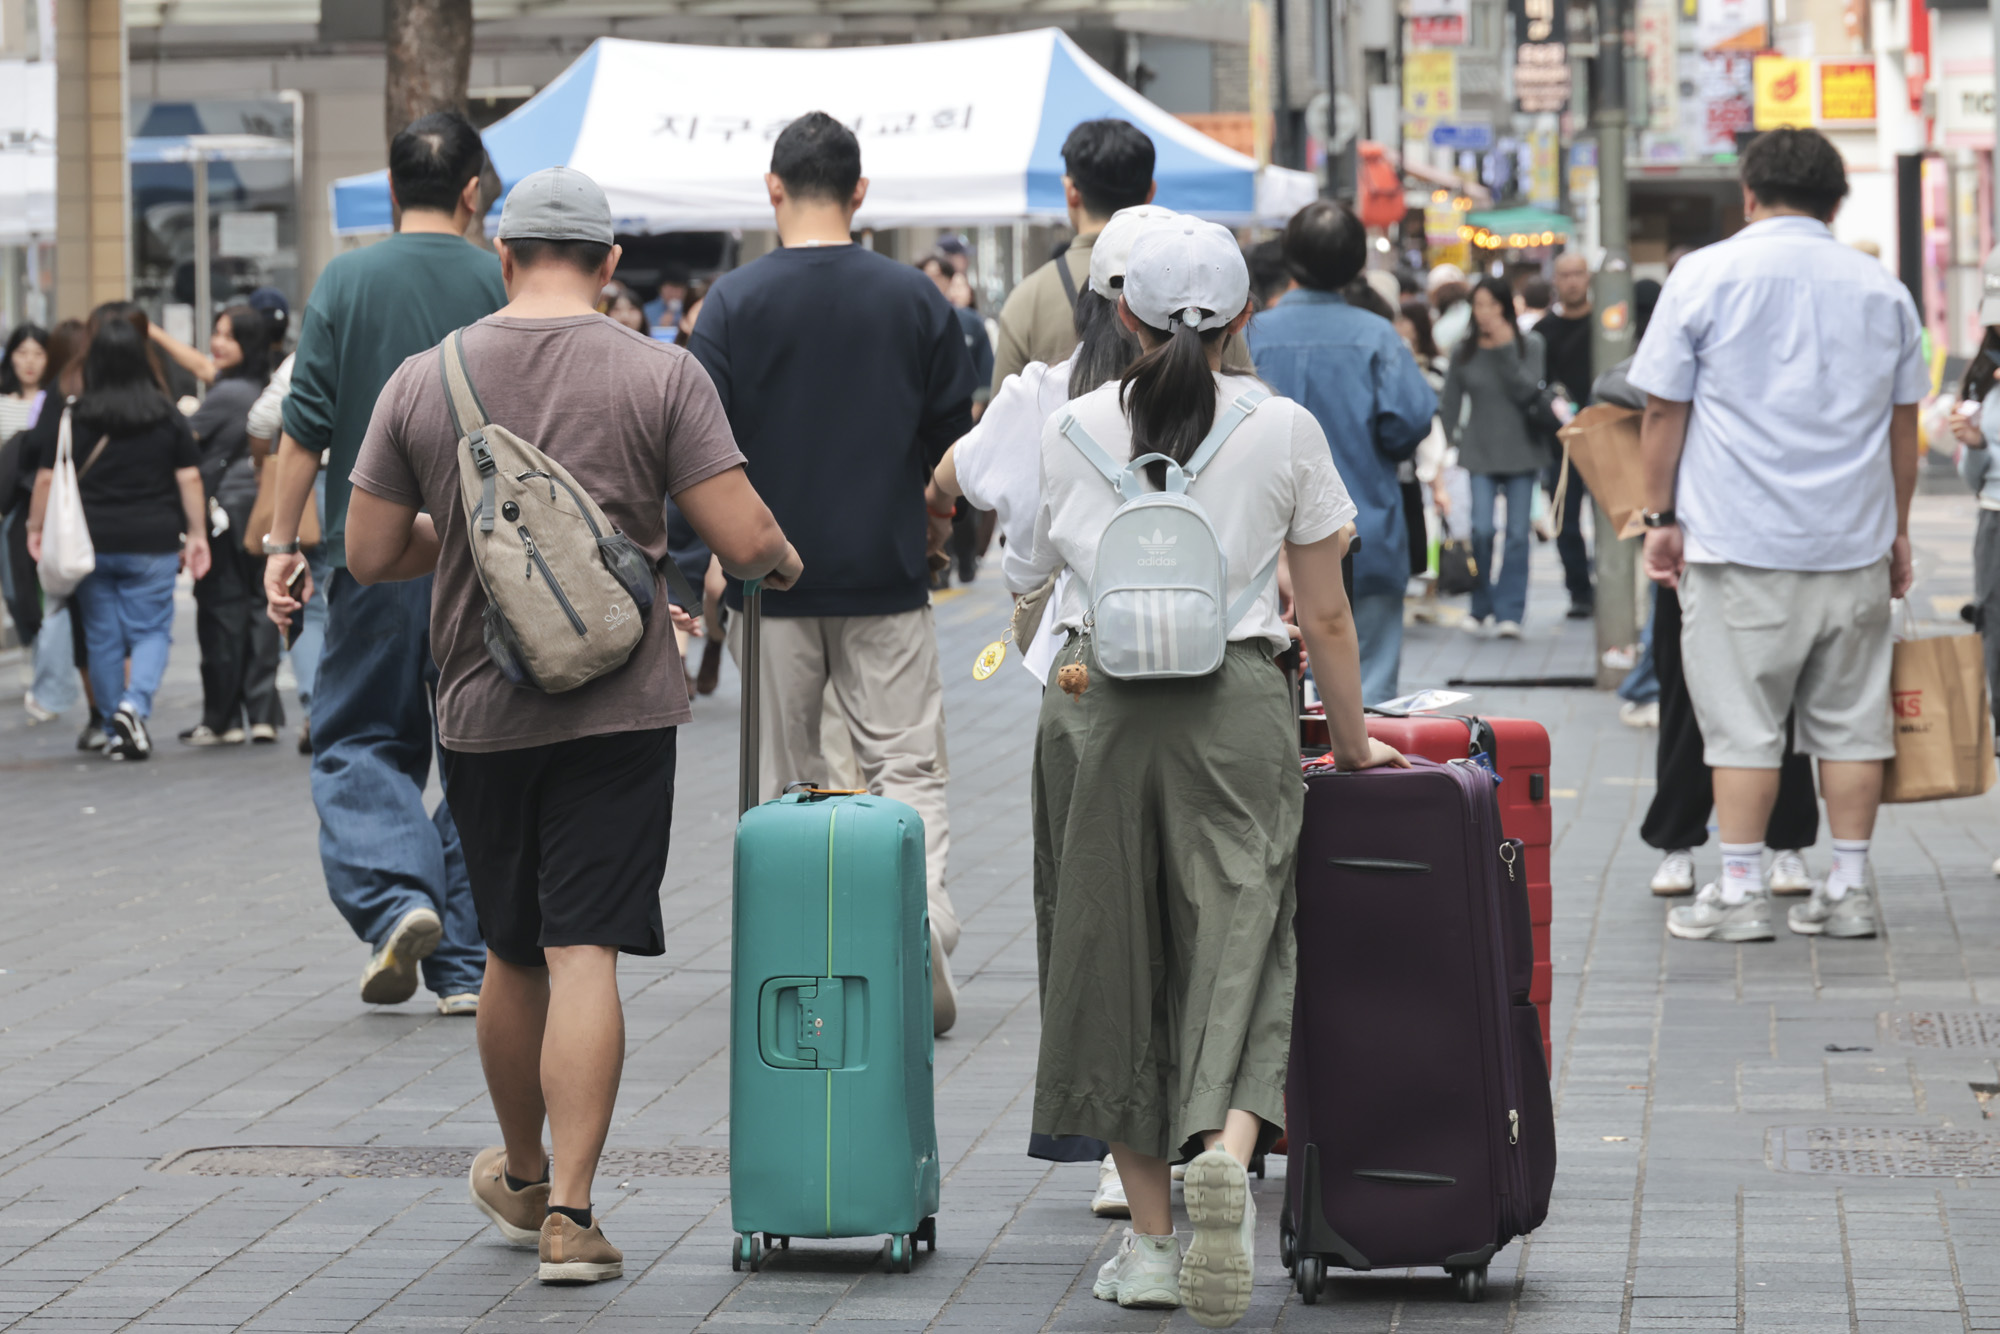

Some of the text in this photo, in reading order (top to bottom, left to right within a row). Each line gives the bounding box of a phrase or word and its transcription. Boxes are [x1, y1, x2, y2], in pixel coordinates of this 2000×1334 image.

[651, 103, 973, 142] 지구교회
[1136, 555, 1177, 567] adidas
[1893, 691, 1923, 718] NS
